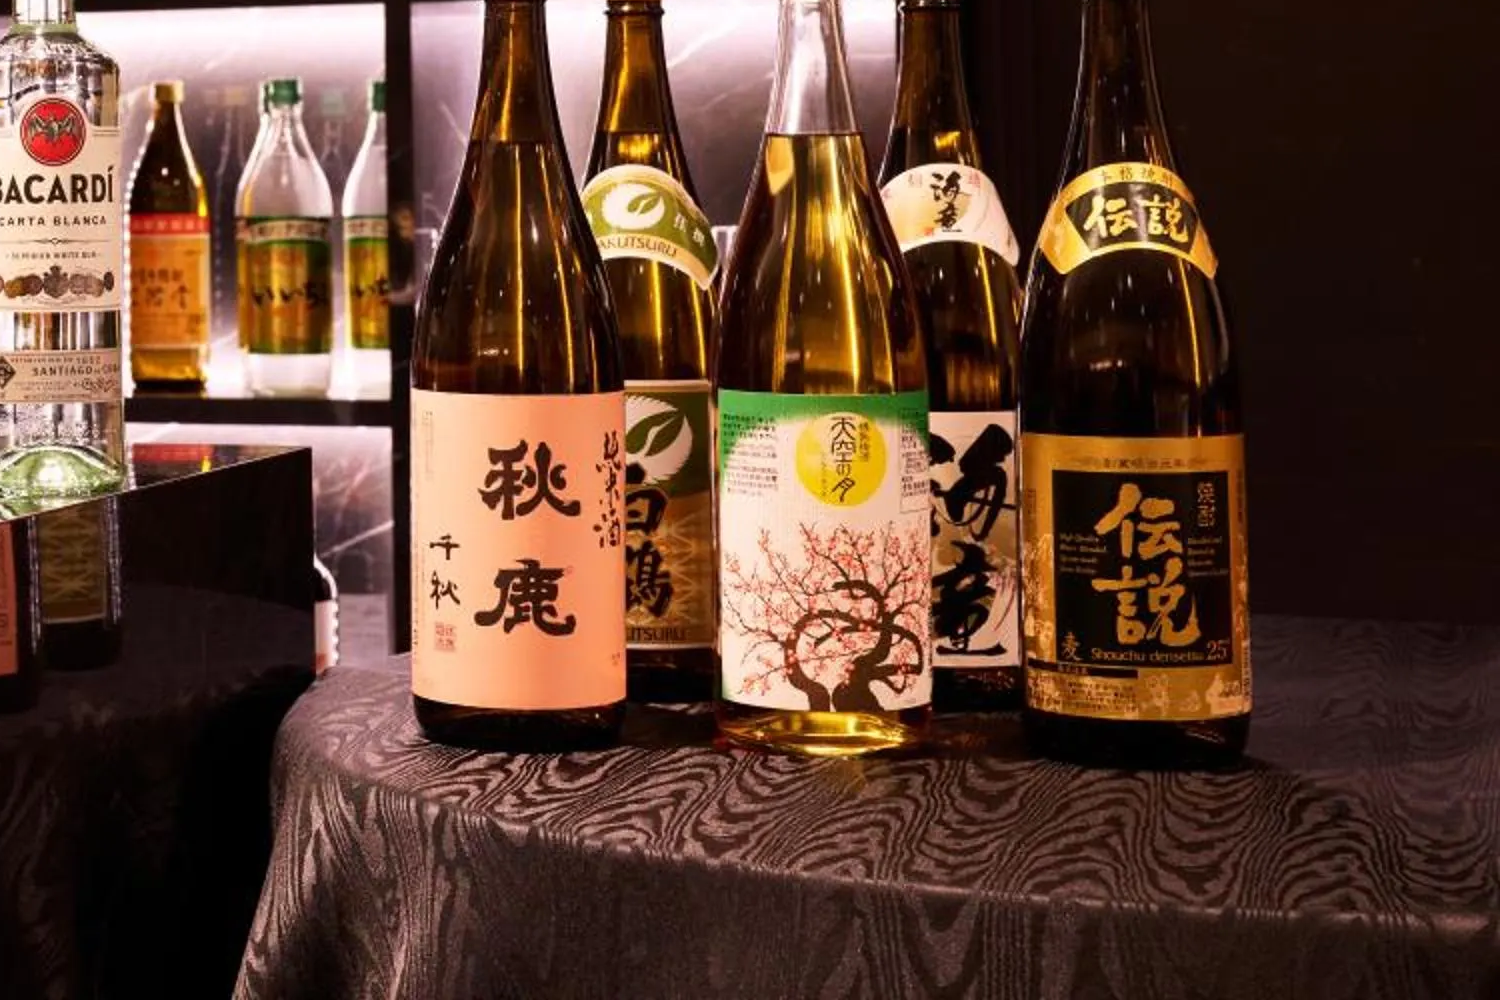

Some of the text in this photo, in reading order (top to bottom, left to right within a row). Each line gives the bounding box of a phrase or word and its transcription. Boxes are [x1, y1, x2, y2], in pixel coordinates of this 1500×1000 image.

[52, 215, 108, 227] BLANCA
[1083, 193, 1189, 244] 伝説
[598, 236, 678, 257] AKUTSURU
[32, 366, 93, 377] SANTIAGO
[474, 439, 582, 636] 秋鹿
[429, 532, 461, 610] 千秋
[1091, 483, 1202, 647] 伝説
